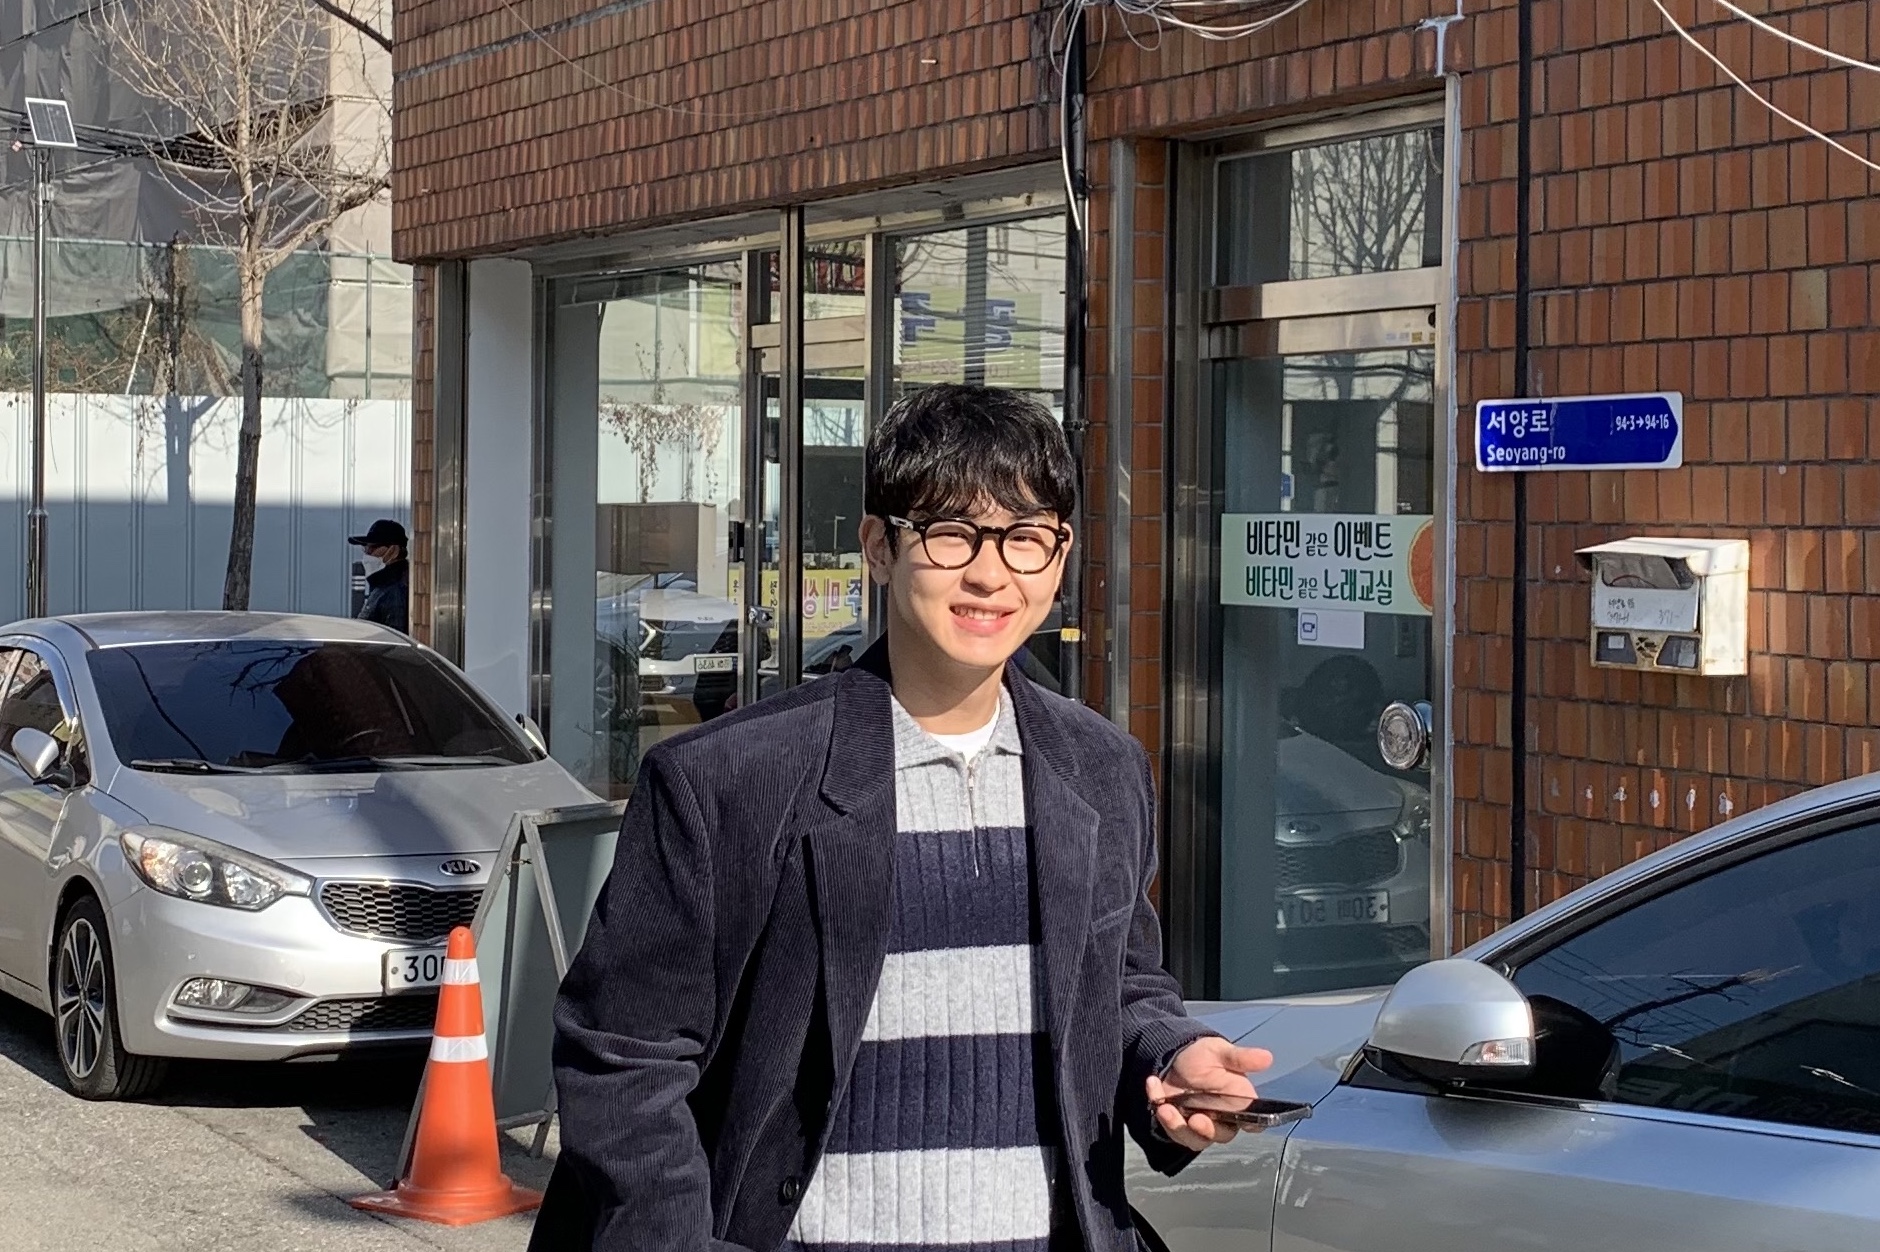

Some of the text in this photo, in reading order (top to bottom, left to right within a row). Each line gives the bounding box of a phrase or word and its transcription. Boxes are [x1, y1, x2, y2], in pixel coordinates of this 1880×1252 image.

[1487, 410, 1550, 439] 서양로
[1487, 444, 1566, 464] Seoyang-ro
[1246, 520, 1394, 561] 비타민 같은 이벤트
[1246, 565, 1393, 606] 비타민 같은 노래교실
[445, 861, 476, 873] KIA
[403, 954, 446, 983] 30
